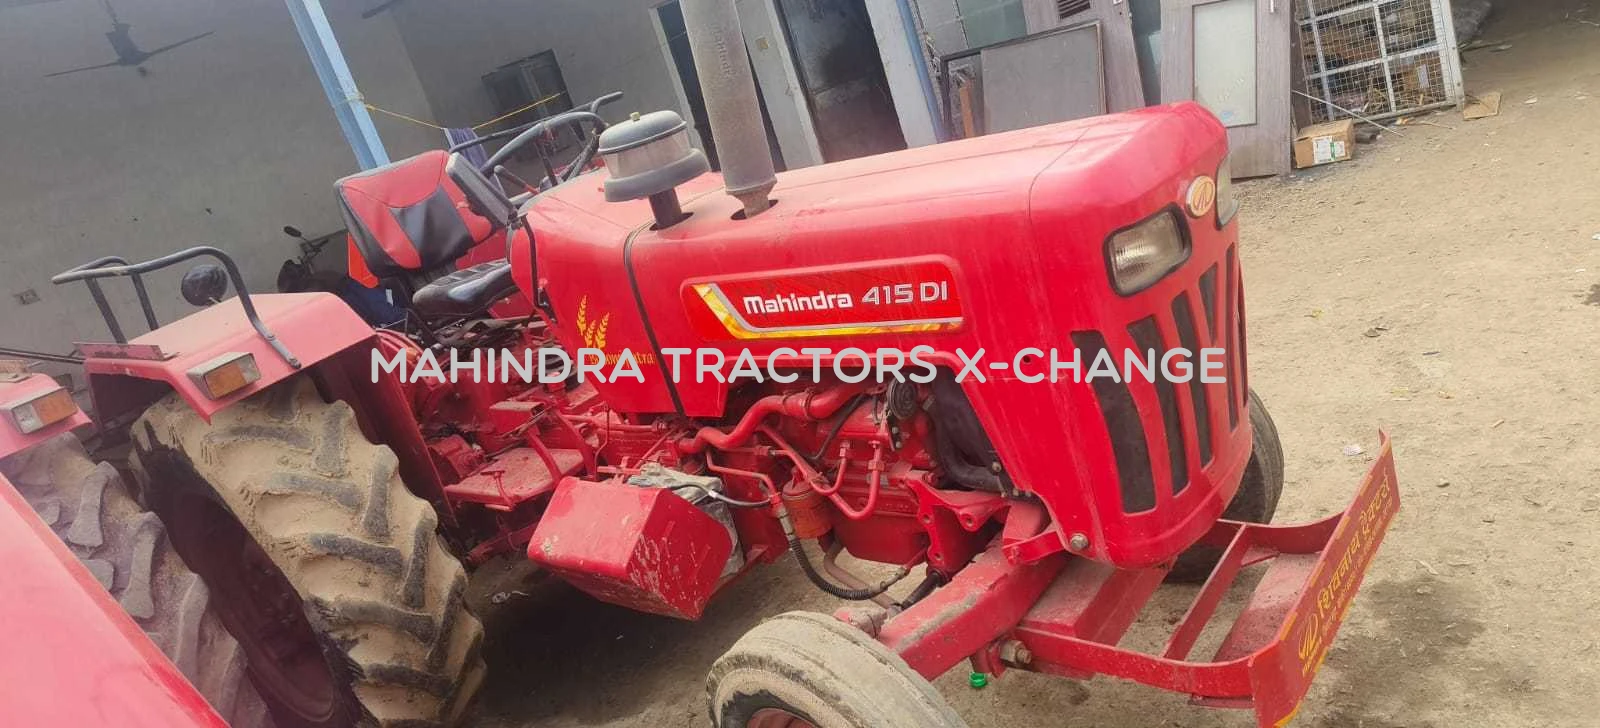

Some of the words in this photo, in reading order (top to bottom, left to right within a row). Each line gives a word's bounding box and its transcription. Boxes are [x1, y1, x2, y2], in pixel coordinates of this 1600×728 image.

[742, 290, 854, 315] Mahindra
[862, 283, 914, 306] 415
[920, 280, 949, 302] DI
